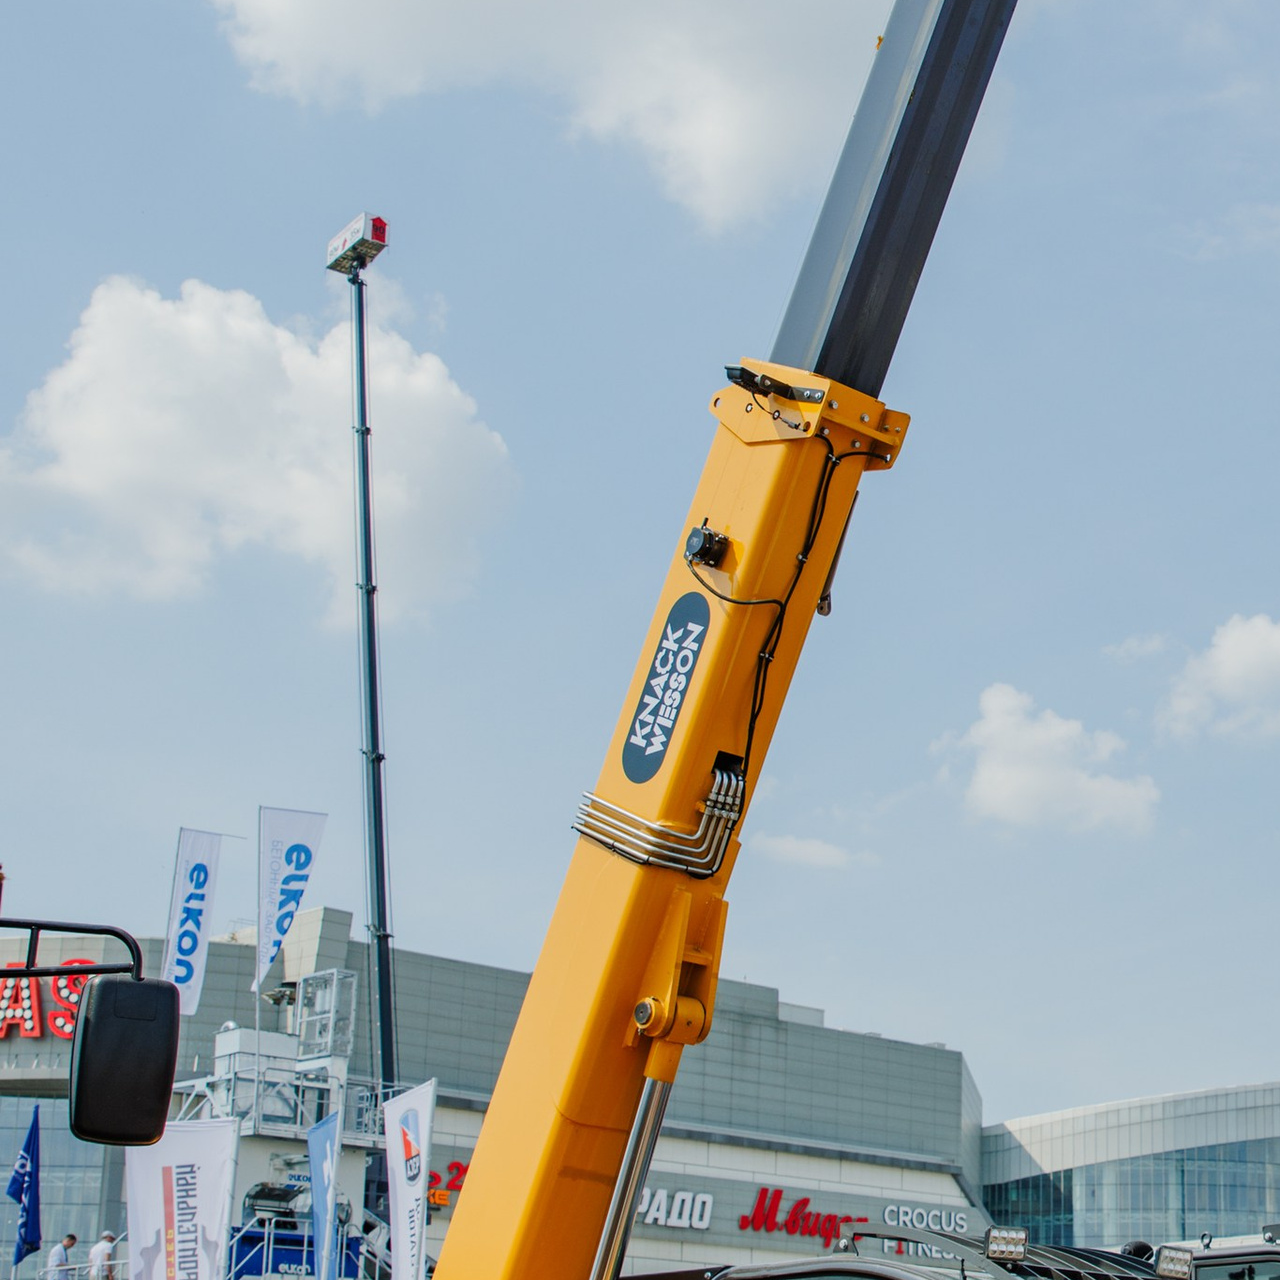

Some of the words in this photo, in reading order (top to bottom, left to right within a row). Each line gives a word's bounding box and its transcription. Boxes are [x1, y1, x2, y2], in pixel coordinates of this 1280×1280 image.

[630, 622, 686, 749] KNACK
[645, 622, 705, 757] WIESSON
[883, 1205, 969, 1234] CROCUS
